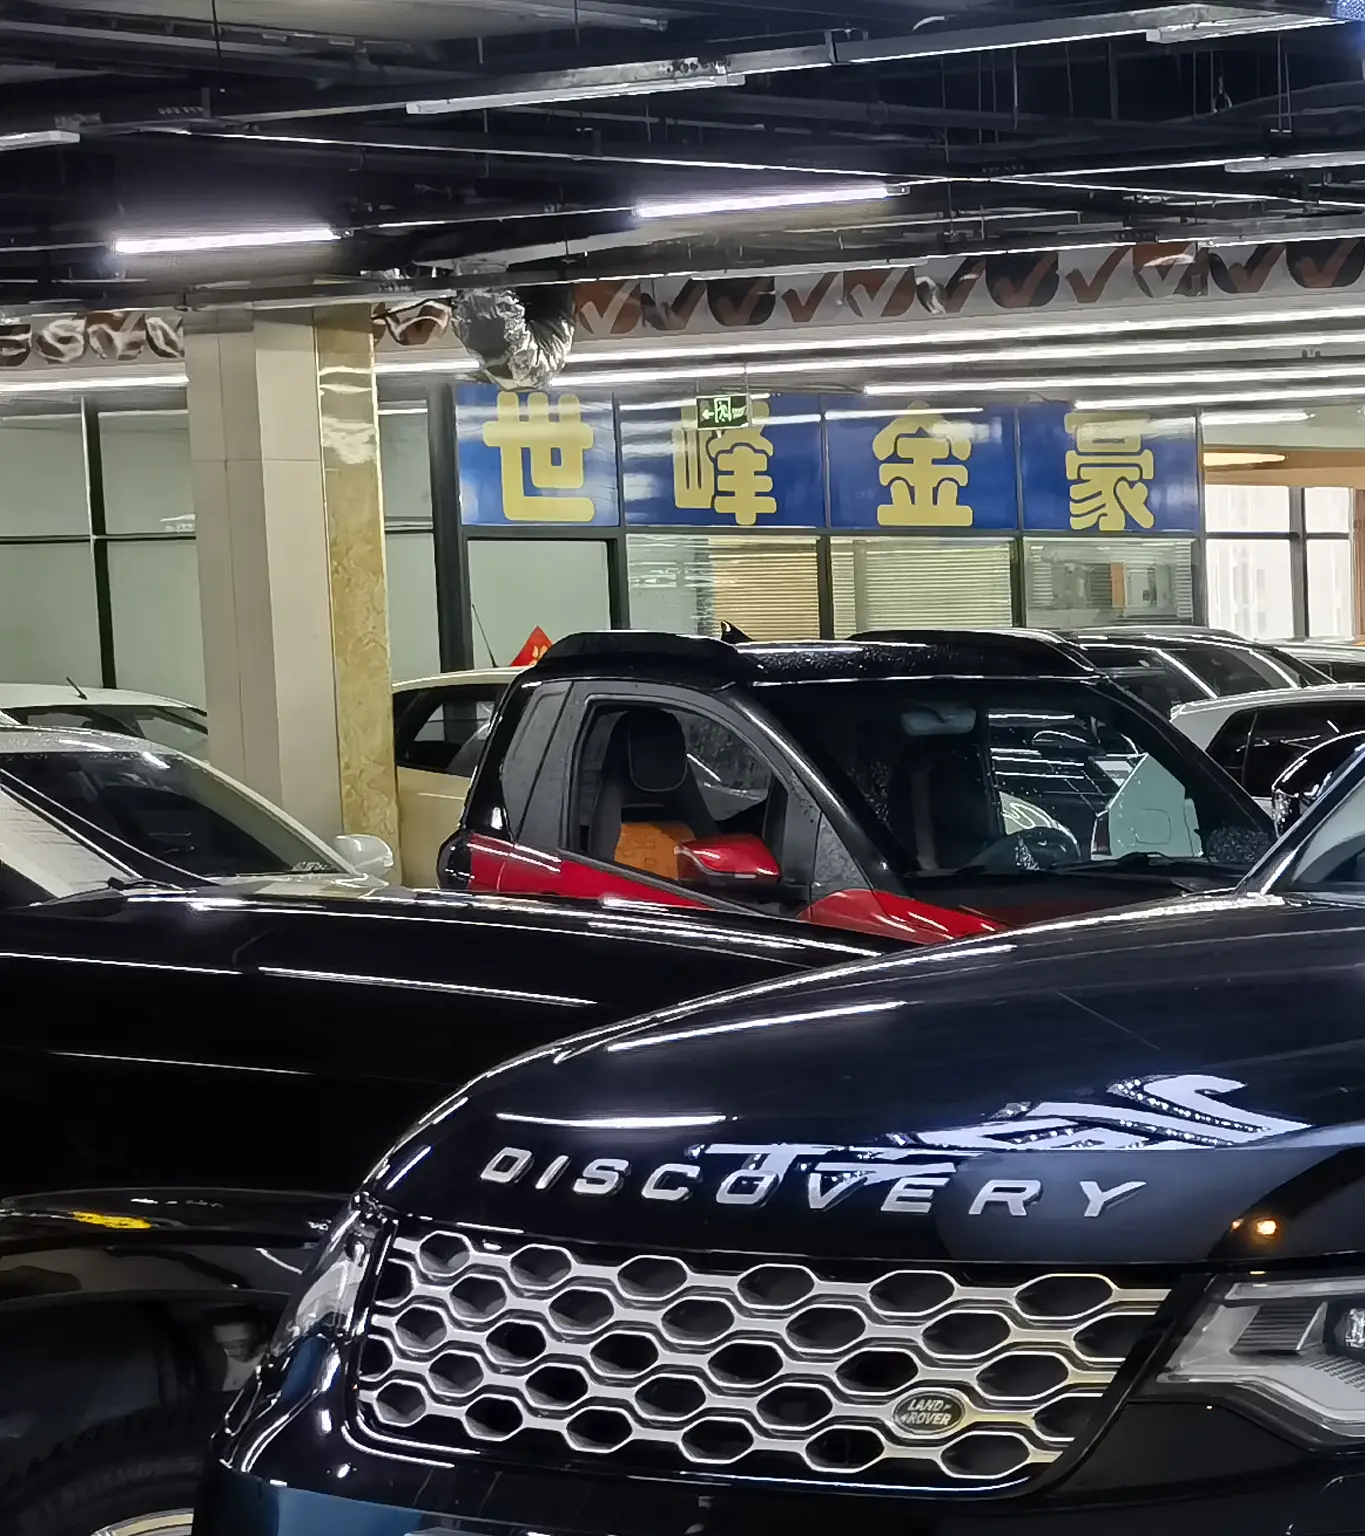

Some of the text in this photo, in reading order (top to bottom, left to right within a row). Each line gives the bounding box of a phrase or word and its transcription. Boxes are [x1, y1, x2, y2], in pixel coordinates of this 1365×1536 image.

[480, 1146, 1147, 1218] DISCOVERY
[907, 1398, 944, 1412] LAND
[906, 1411, 952, 1426] ROVER
